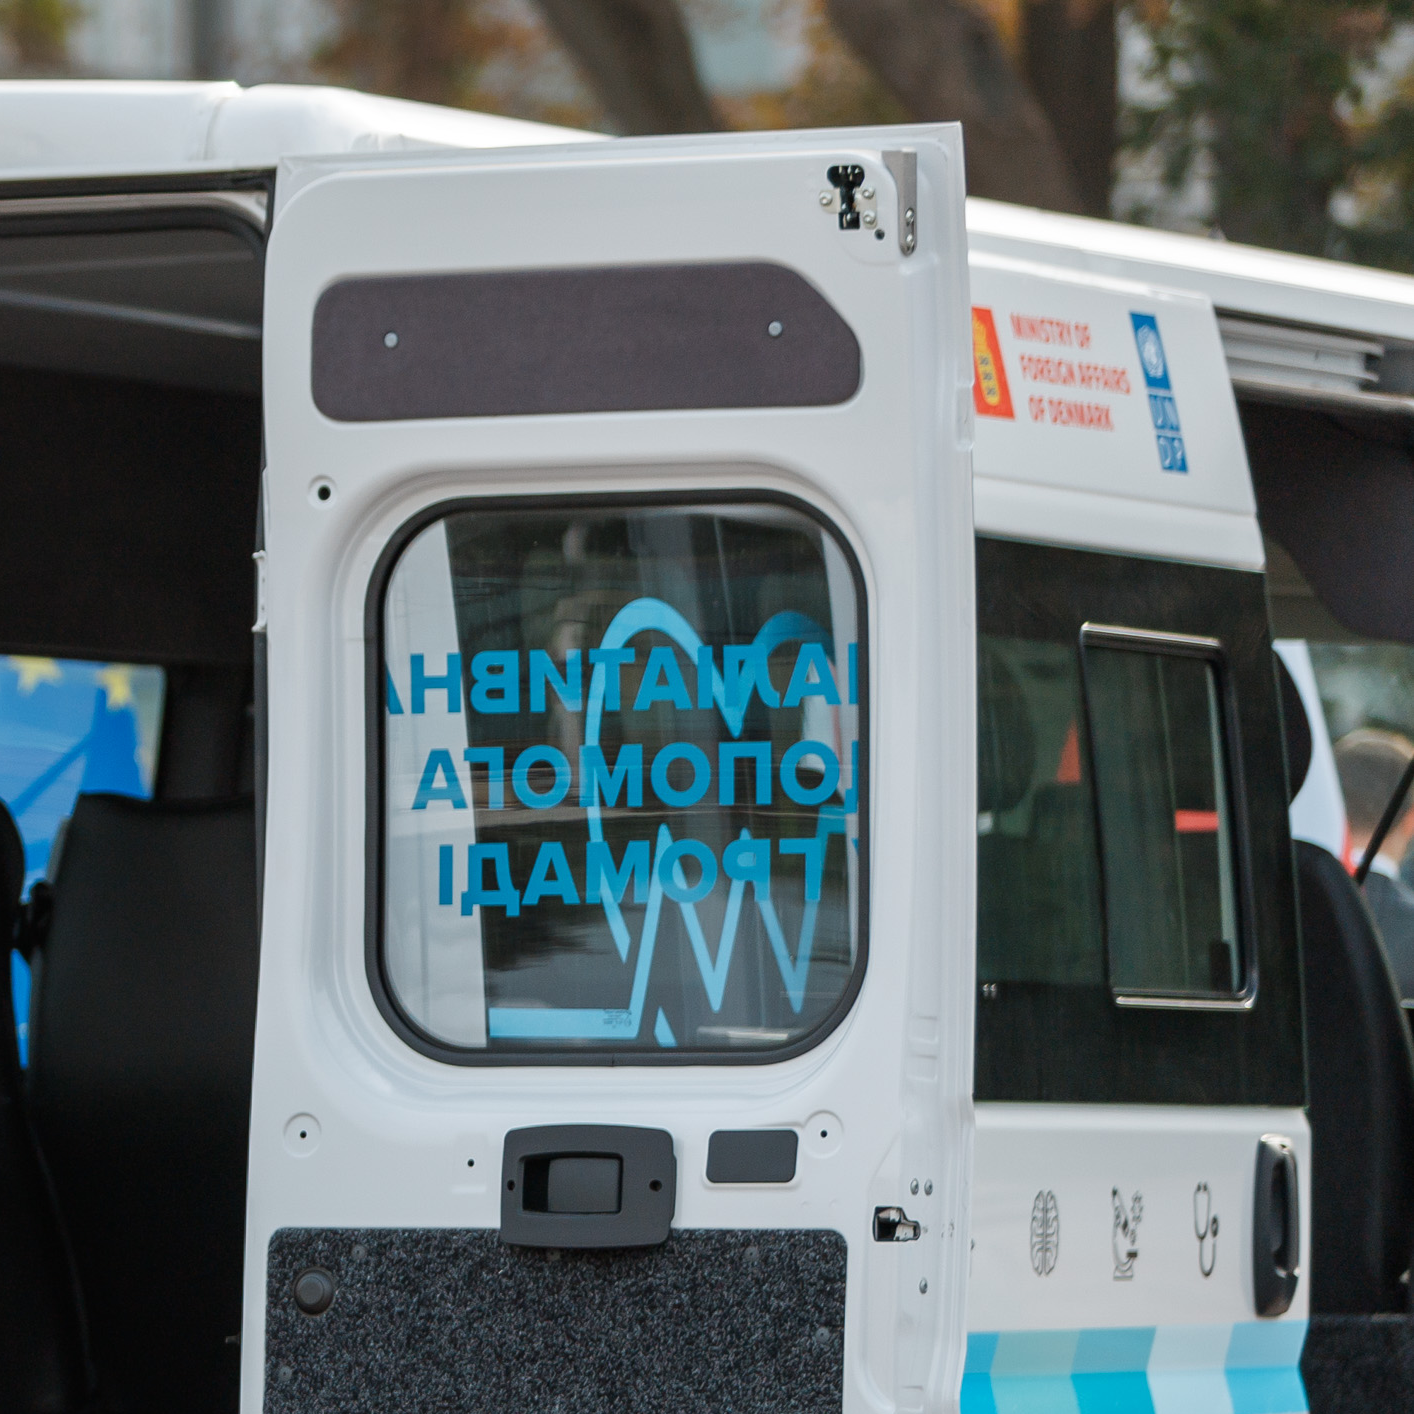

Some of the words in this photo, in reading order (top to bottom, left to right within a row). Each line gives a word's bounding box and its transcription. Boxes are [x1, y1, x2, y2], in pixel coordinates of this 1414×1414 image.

[1010, 312, 1072, 346] MINISTRY
[1074, 322, 1091, 349] OF
[1020, 353, 1076, 384] FOREIGN
[1078, 361, 1131, 395] AFFAIRS
[1029, 394, 1045, 422] OF
[1048, 397, 1114, 431] DENMARK
